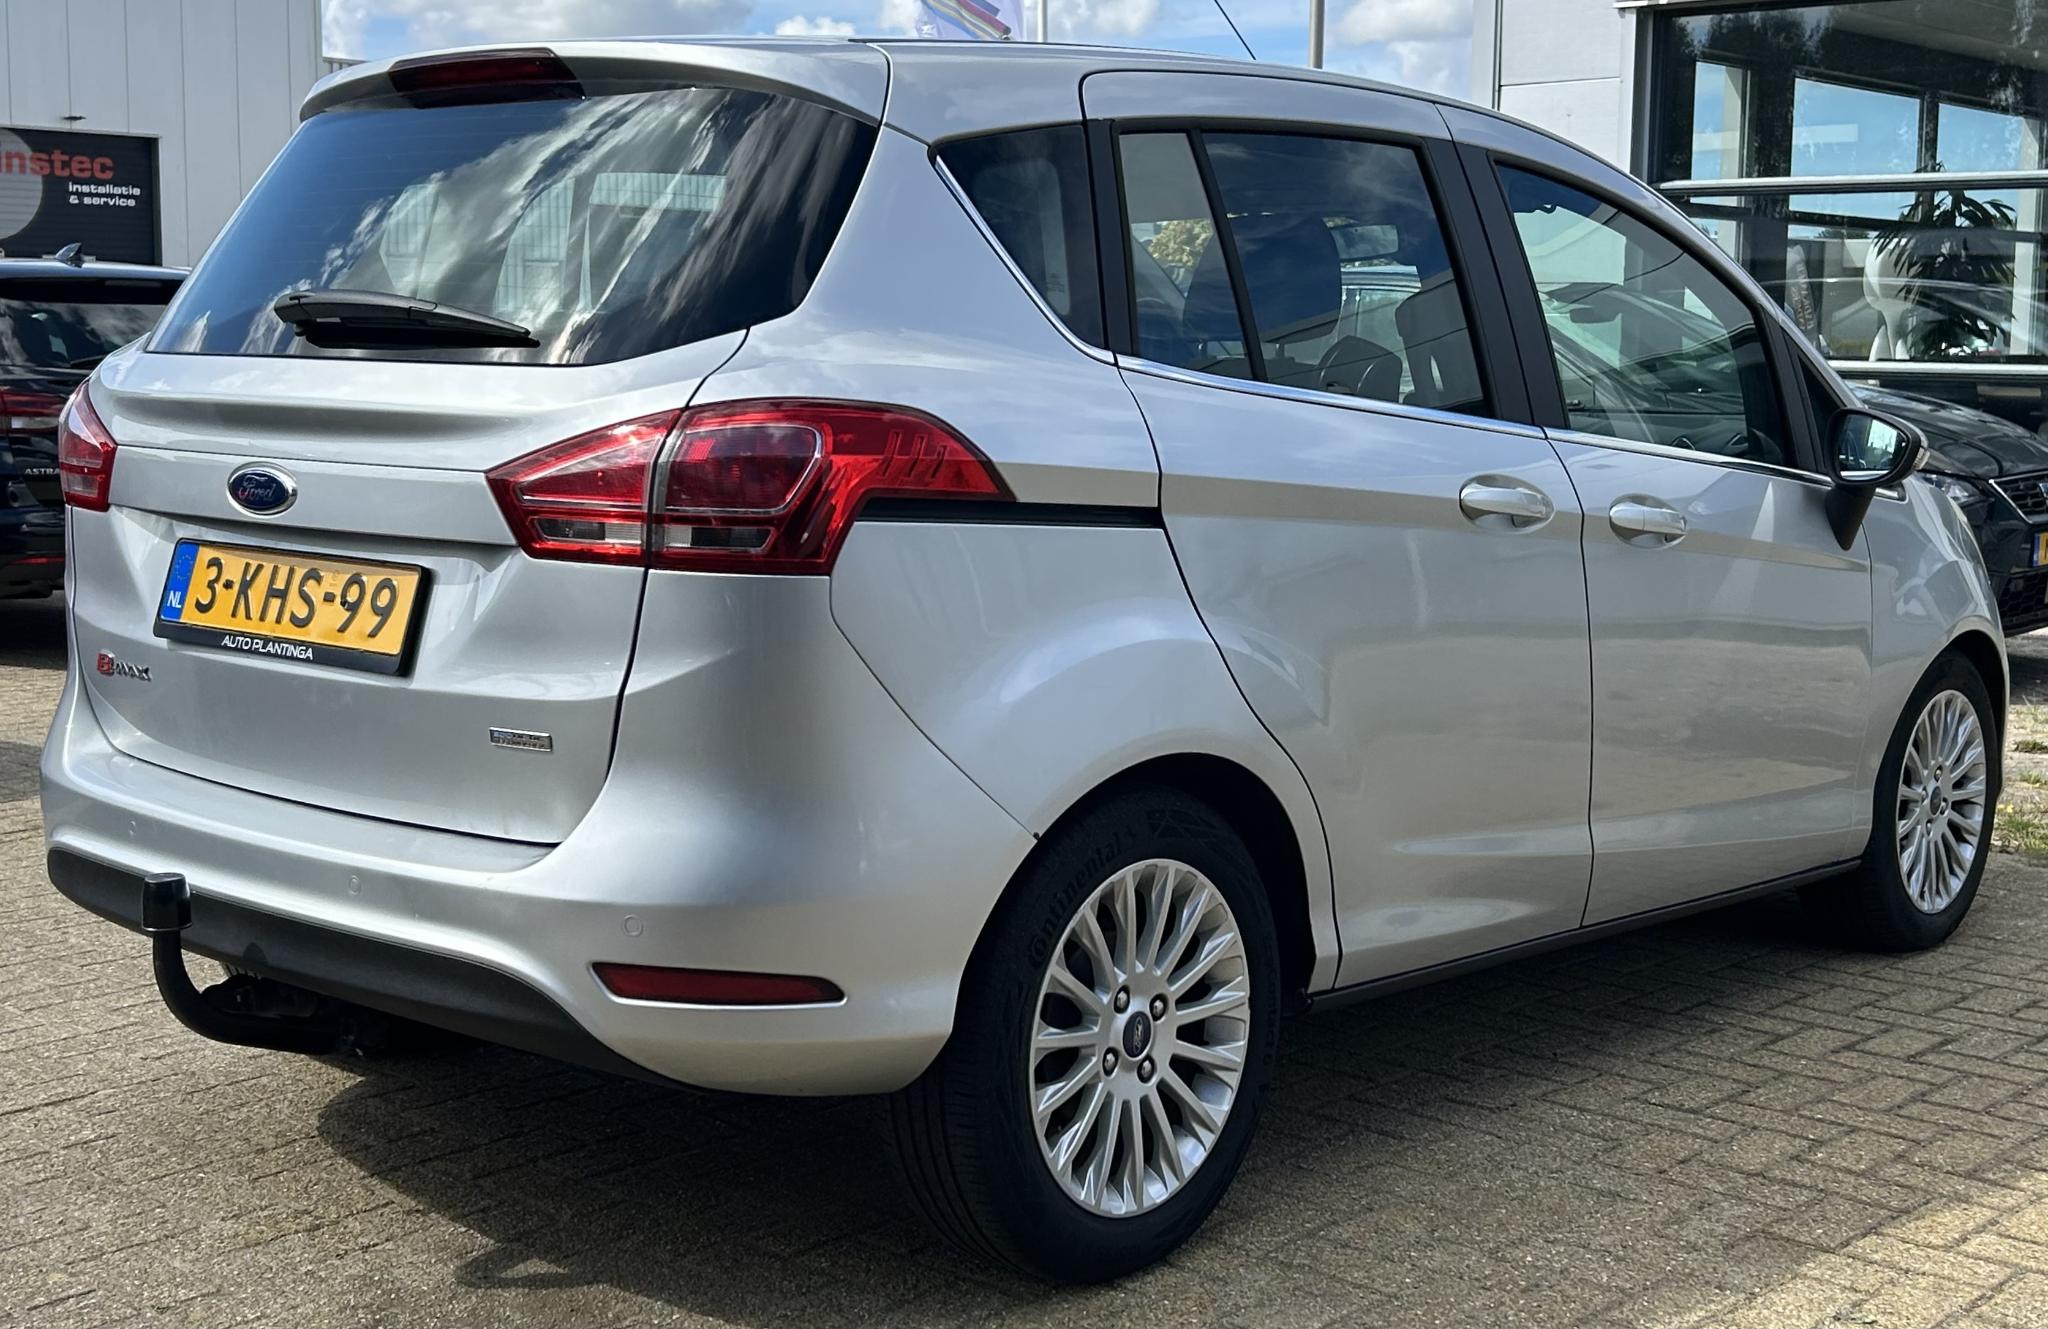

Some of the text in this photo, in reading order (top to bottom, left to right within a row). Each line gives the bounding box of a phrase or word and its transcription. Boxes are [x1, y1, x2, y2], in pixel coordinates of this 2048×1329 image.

[0, 148, 113, 180] nstec
[68, 181, 141, 196] installatie
[69, 195, 136, 207] & service
[239, 474, 277, 500] Ford
[167, 590, 182, 609] NL
[194, 556, 399, 638] 3-KHS-99
[221, 635, 313, 660] AUTO PLANTINGA
